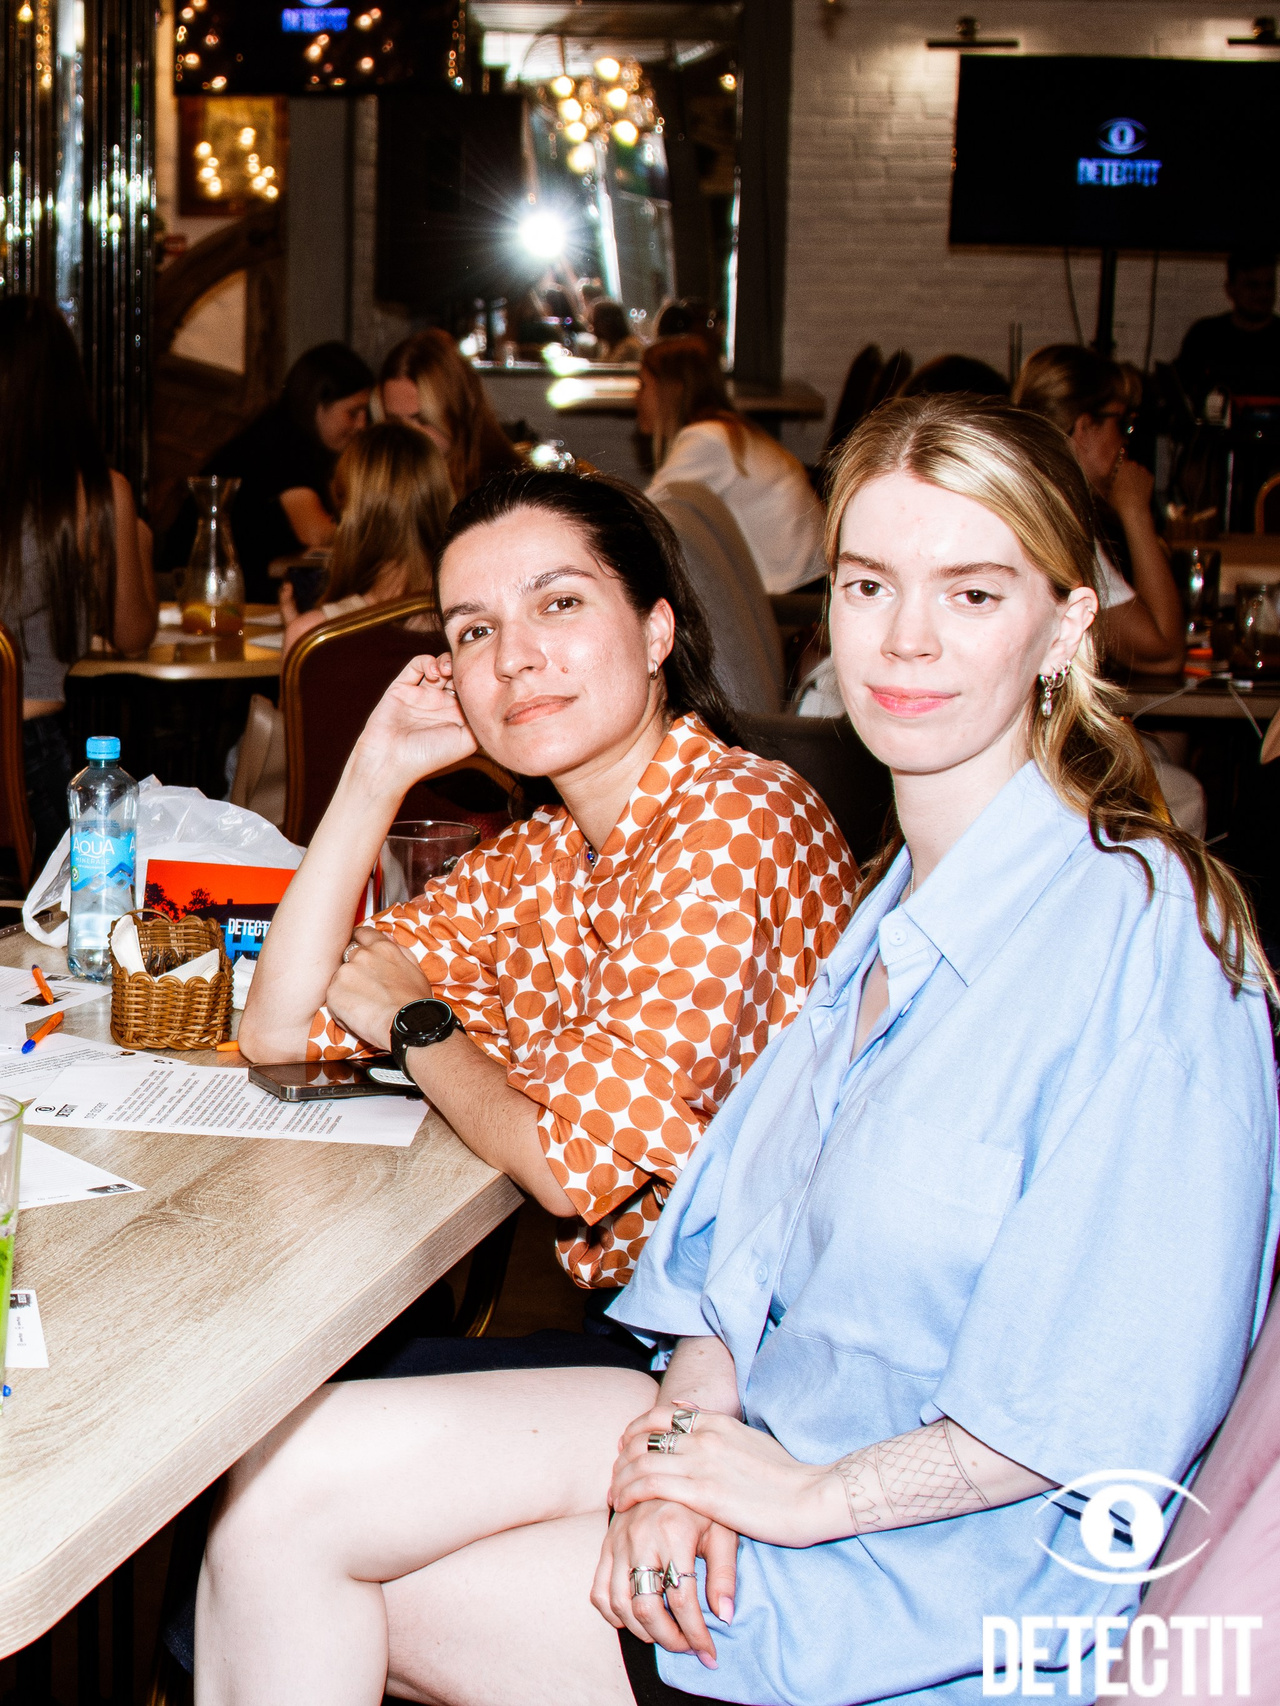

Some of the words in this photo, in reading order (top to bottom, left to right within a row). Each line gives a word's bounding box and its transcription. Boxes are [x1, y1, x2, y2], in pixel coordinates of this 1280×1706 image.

[73, 837, 115, 858] AQUA
[75, 857, 110, 865] MINERALE
[227, 917, 272, 938] DETECT
